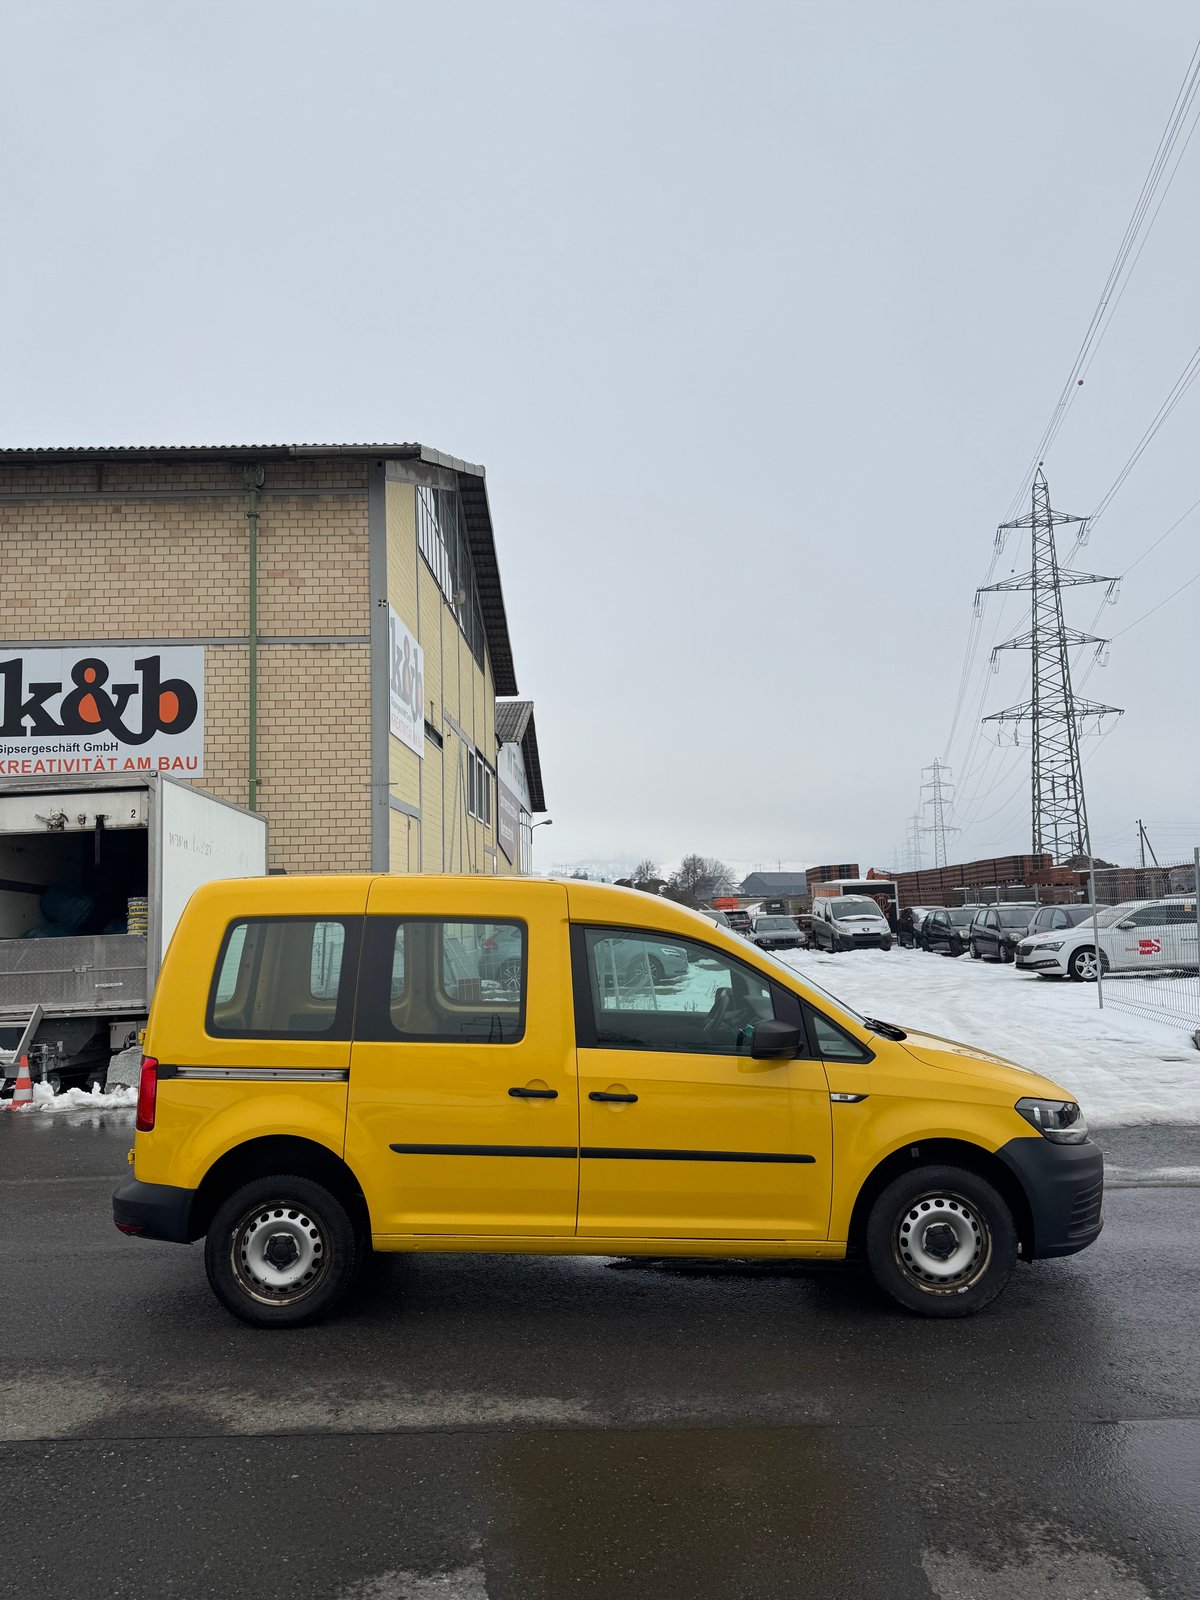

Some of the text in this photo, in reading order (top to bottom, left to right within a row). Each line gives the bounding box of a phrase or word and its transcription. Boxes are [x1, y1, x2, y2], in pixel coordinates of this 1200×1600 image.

[390, 616, 423, 723] k&b
[0, 655, 198, 745] k&b
[83, 742, 119, 752] GmbH
[123, 757, 151, 771] AM
[158, 756, 198, 771] BAU
[130, 808, 136, 819] 2
